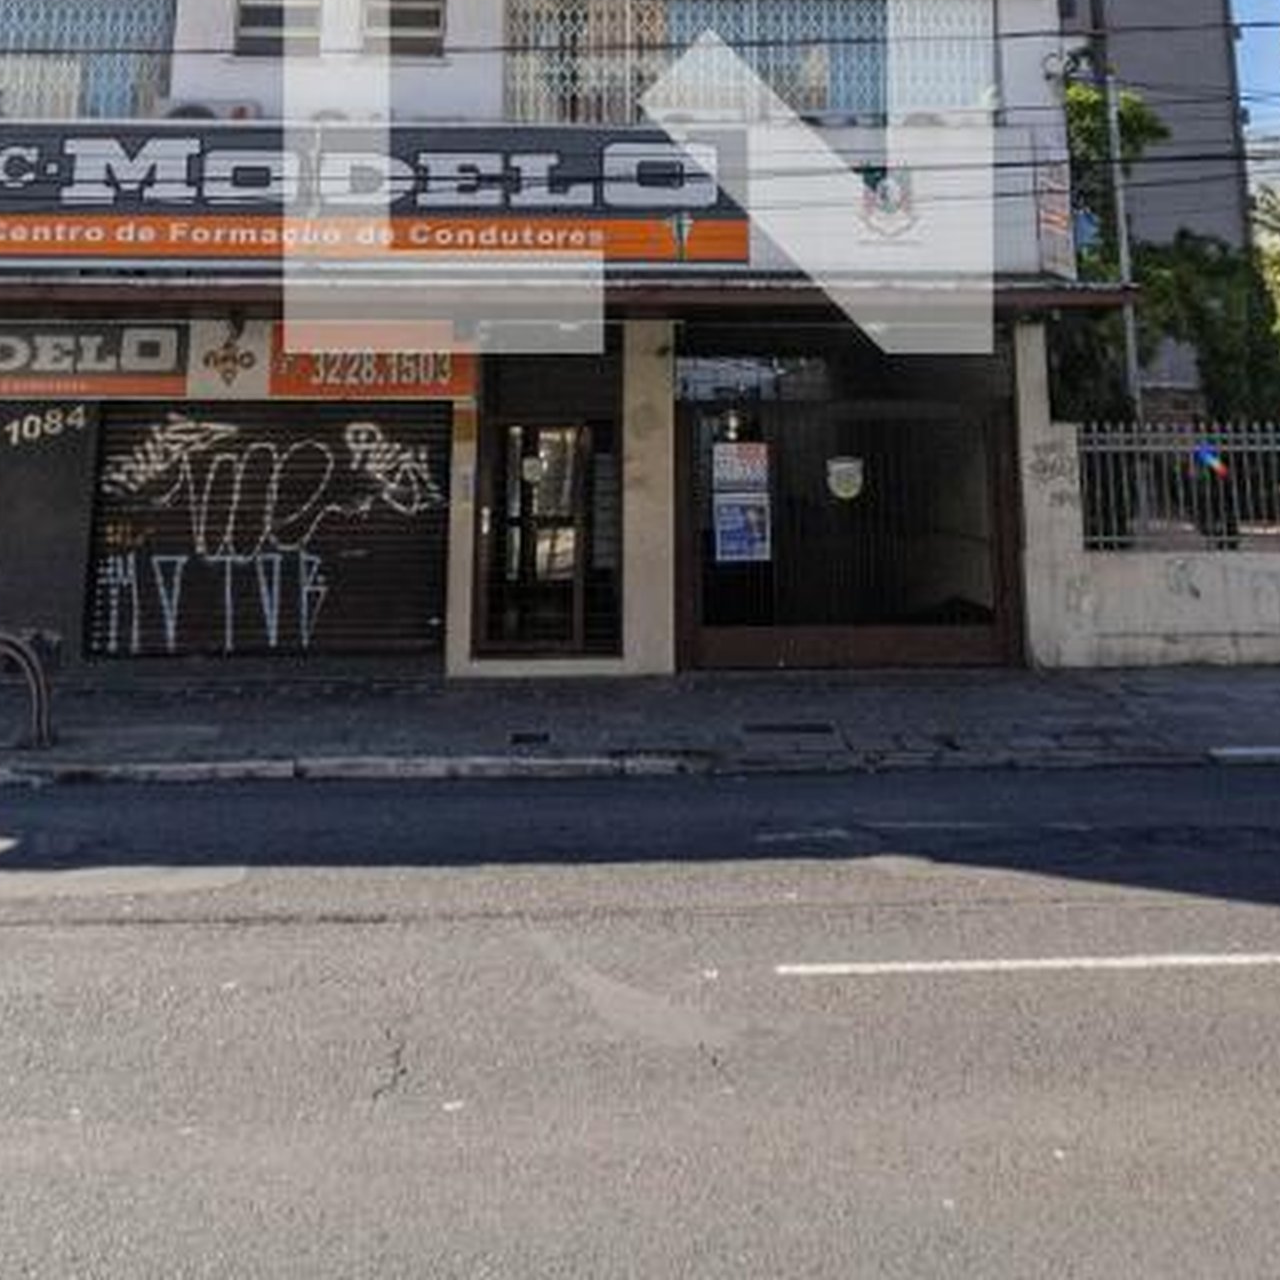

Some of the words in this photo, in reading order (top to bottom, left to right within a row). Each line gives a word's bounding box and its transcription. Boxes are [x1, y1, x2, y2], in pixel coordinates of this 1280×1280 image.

[60, 136, 719, 208] MODELO
[115, 220, 156, 243] de
[355, 223, 395, 247] de
[408, 222, 606, 248] Condutores
[3, 403, 86, 447] 1084
